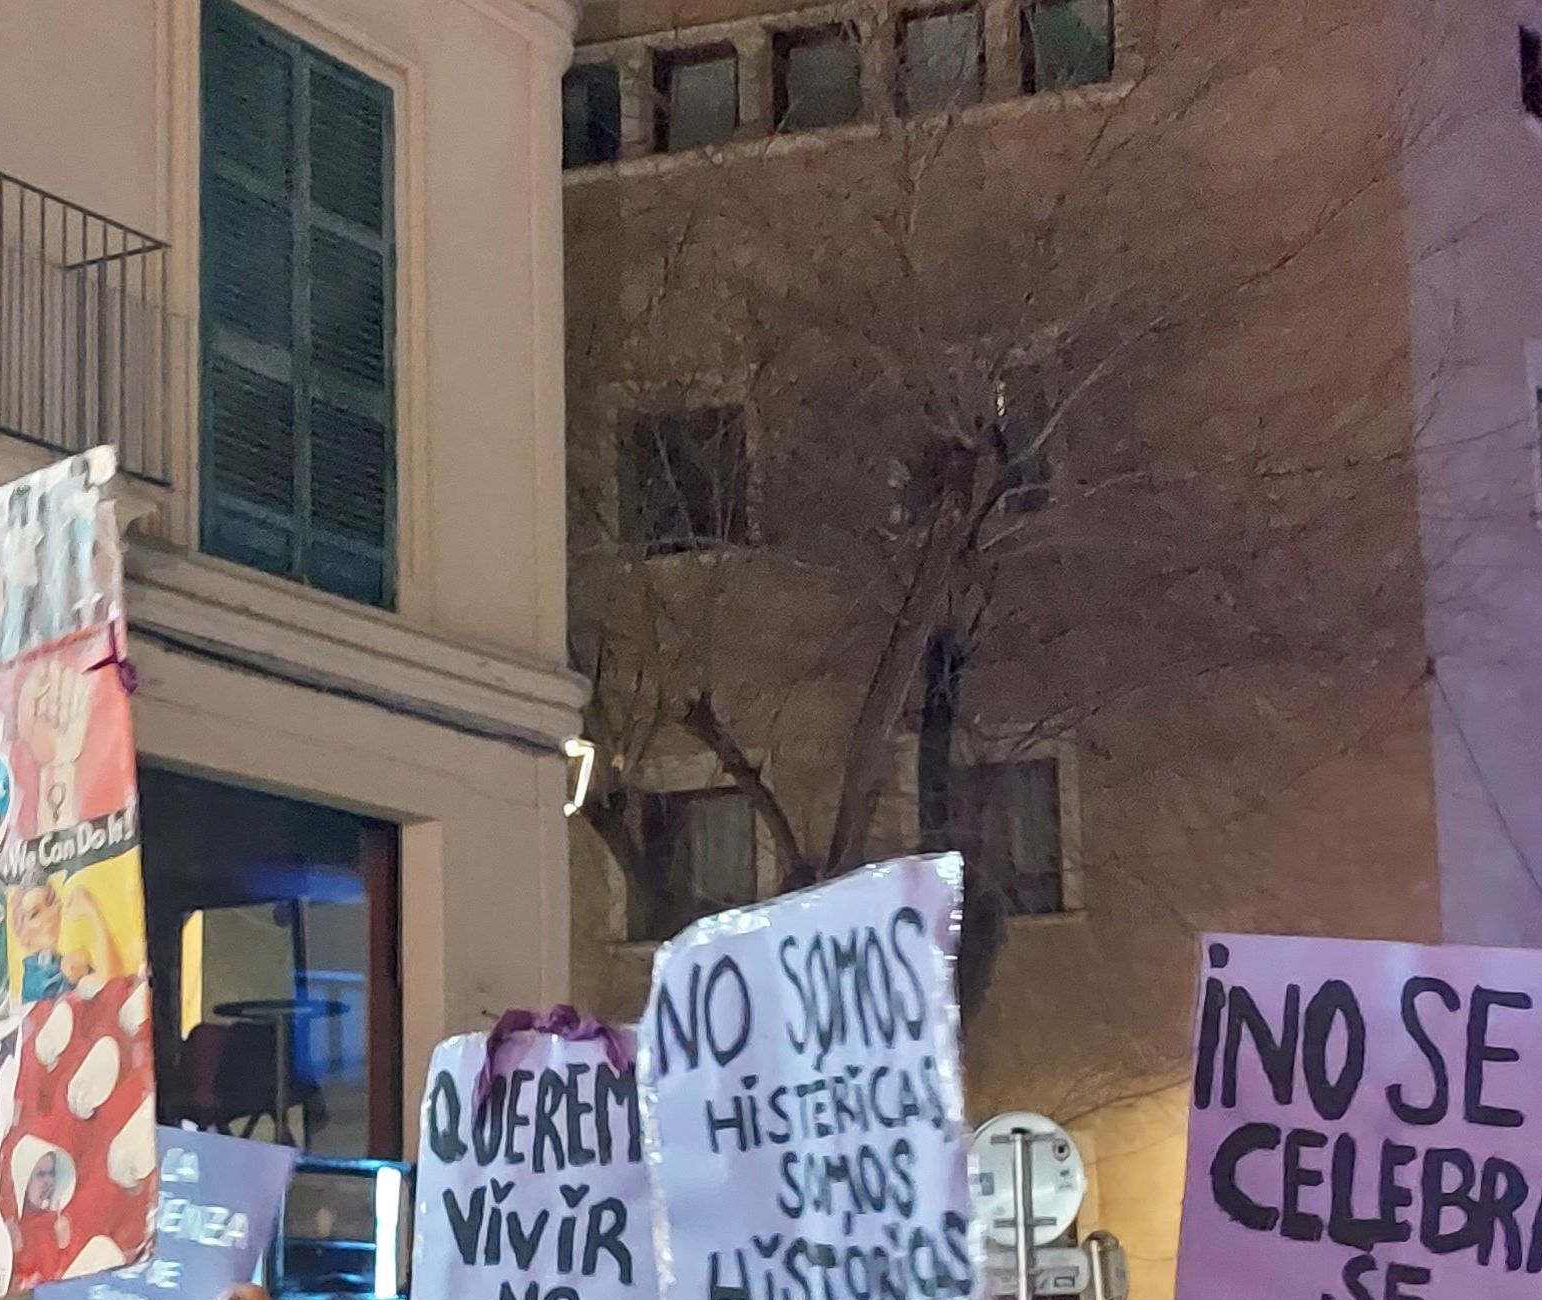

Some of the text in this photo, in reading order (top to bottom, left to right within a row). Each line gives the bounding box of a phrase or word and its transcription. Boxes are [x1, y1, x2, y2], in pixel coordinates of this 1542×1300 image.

[38, 831, 76, 868] Can
[76, 821, 107, 857] Do
[658, 906, 925, 1077] NO SOMOS
[1194, 943, 1533, 1128] ¡NO SE
[427, 1061, 643, 1173] QUEREM
[442, 1177, 634, 1285] VIVIR
[776, 1137, 917, 1219] SOMOS
